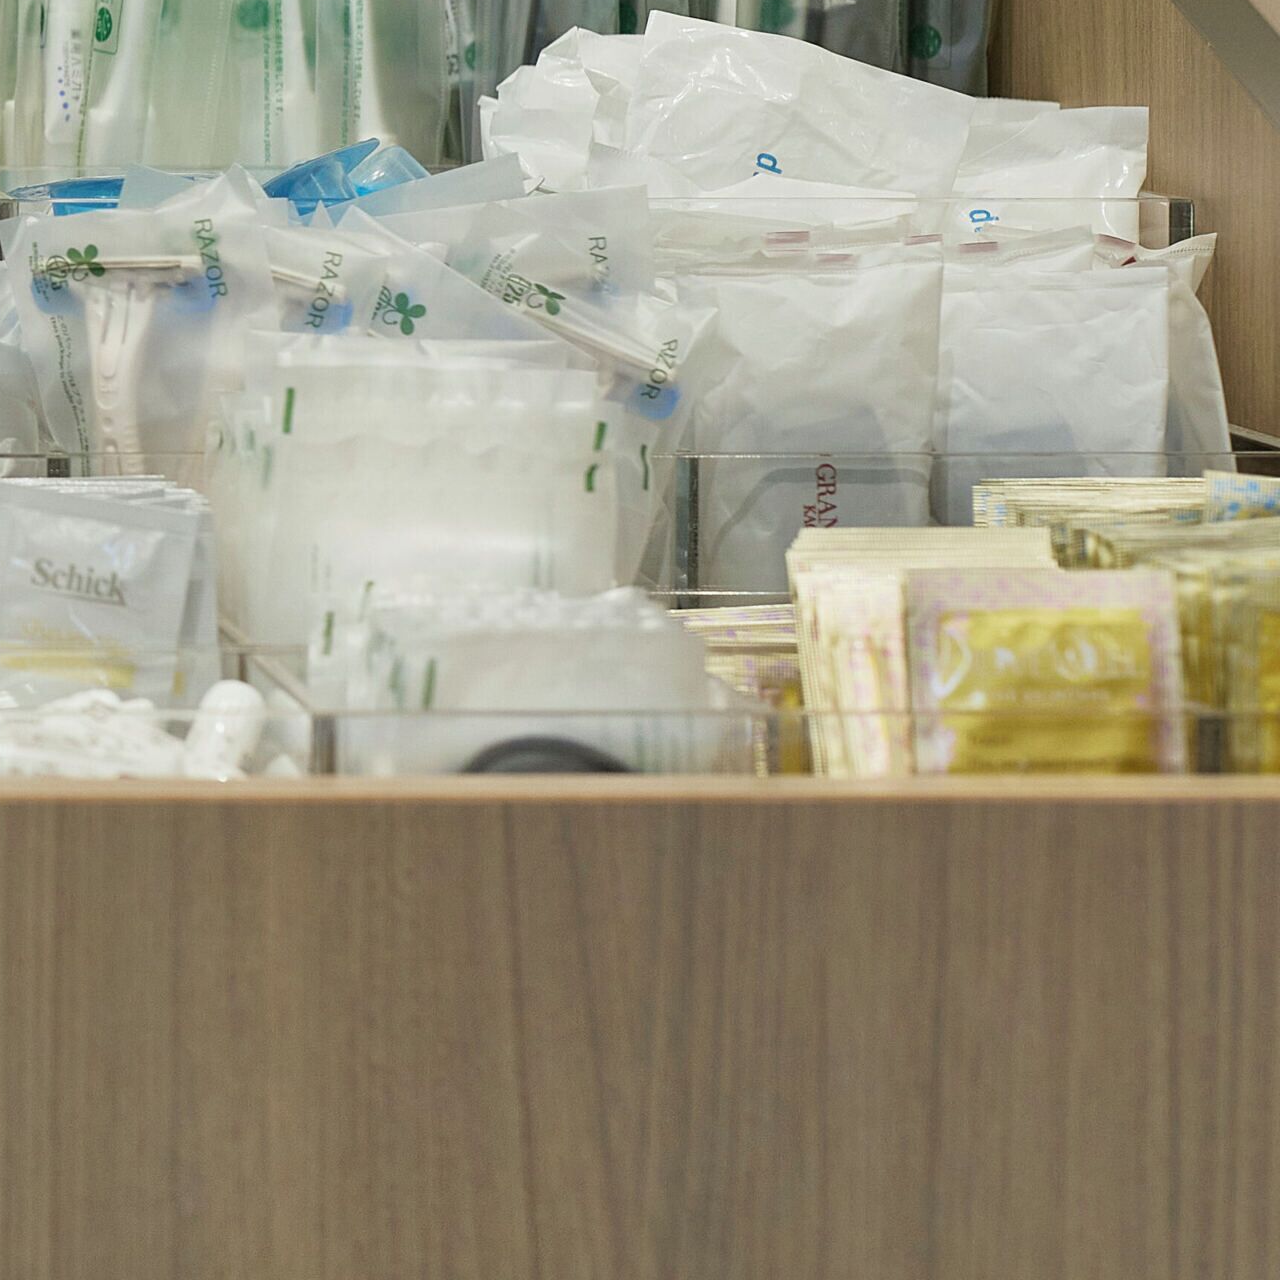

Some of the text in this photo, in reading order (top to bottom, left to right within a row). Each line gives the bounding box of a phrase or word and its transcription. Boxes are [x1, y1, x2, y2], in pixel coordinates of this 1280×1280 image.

[194, 218, 228, 298] RAZOR
[304, 250, 343, 328] RAZOR
[502, 283, 525, 306] 25
[30, 557, 126, 602] Schick
